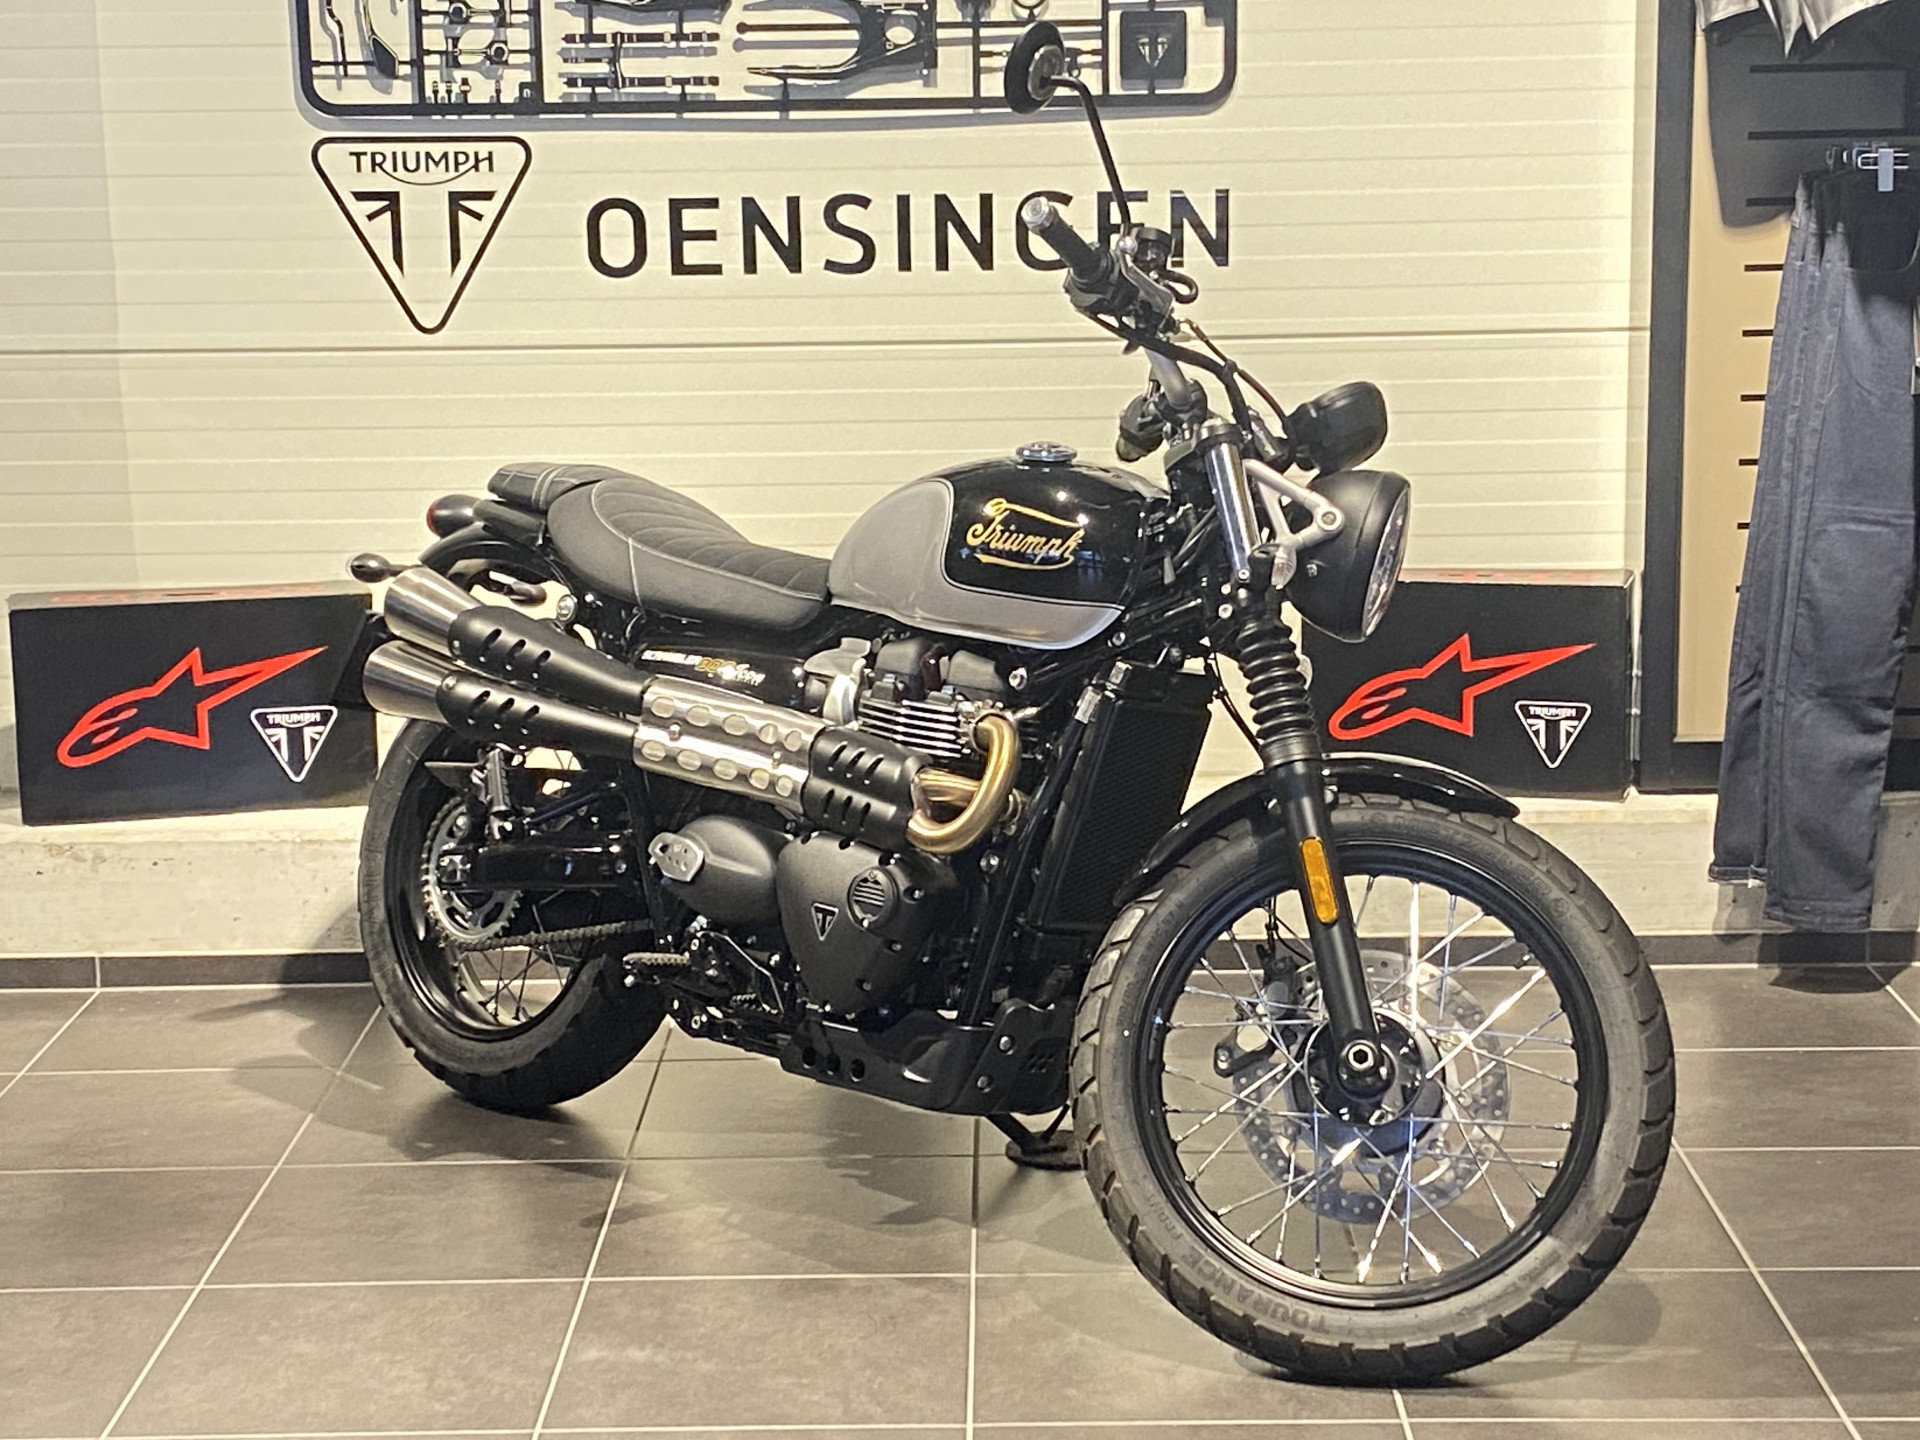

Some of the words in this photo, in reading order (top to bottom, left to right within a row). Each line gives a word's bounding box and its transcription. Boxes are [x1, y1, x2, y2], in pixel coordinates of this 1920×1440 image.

[348, 150, 495, 185] TRIUMPH
[966, 497, 1086, 570] Triumph
[265, 711, 321, 727] TRIUMPH
[1528, 705, 1577, 719] TRIUMPH
[1180, 1244, 1330, 1335] TOURANCE
